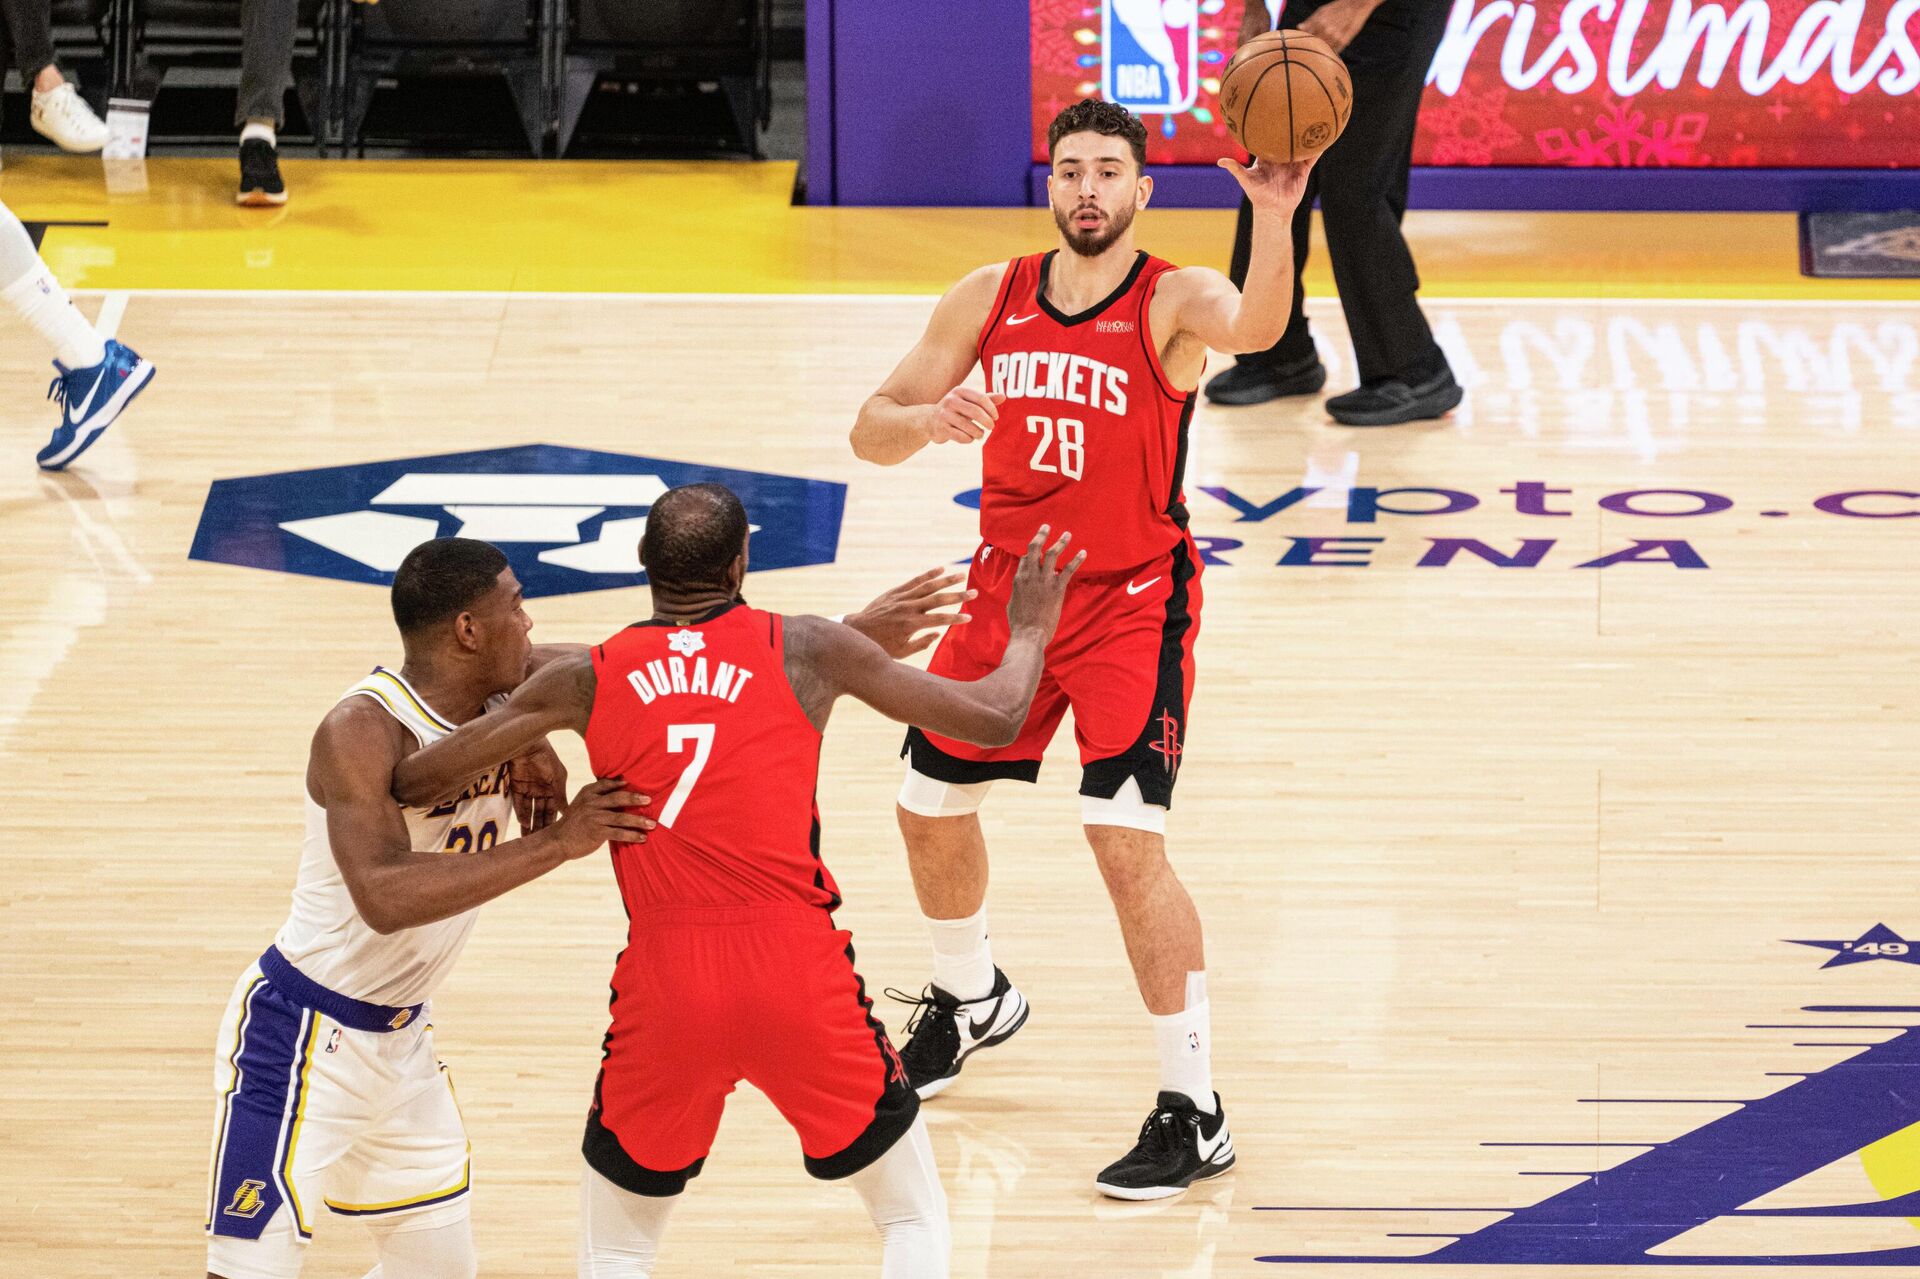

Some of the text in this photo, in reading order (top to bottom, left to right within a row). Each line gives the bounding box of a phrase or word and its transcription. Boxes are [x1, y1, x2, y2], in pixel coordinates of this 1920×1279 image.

[1424, 0, 1920, 96] ristmas
[1117, 63, 1162, 99] NBA
[992, 351, 1129, 417] ROCKETS
[1026, 415, 1085, 482] 28
[953, 481, 1920, 523] ypto.c
[626, 656, 753, 705] DURANT
[658, 723, 716, 829] 7
[1843, 942, 1909, 955] '49
